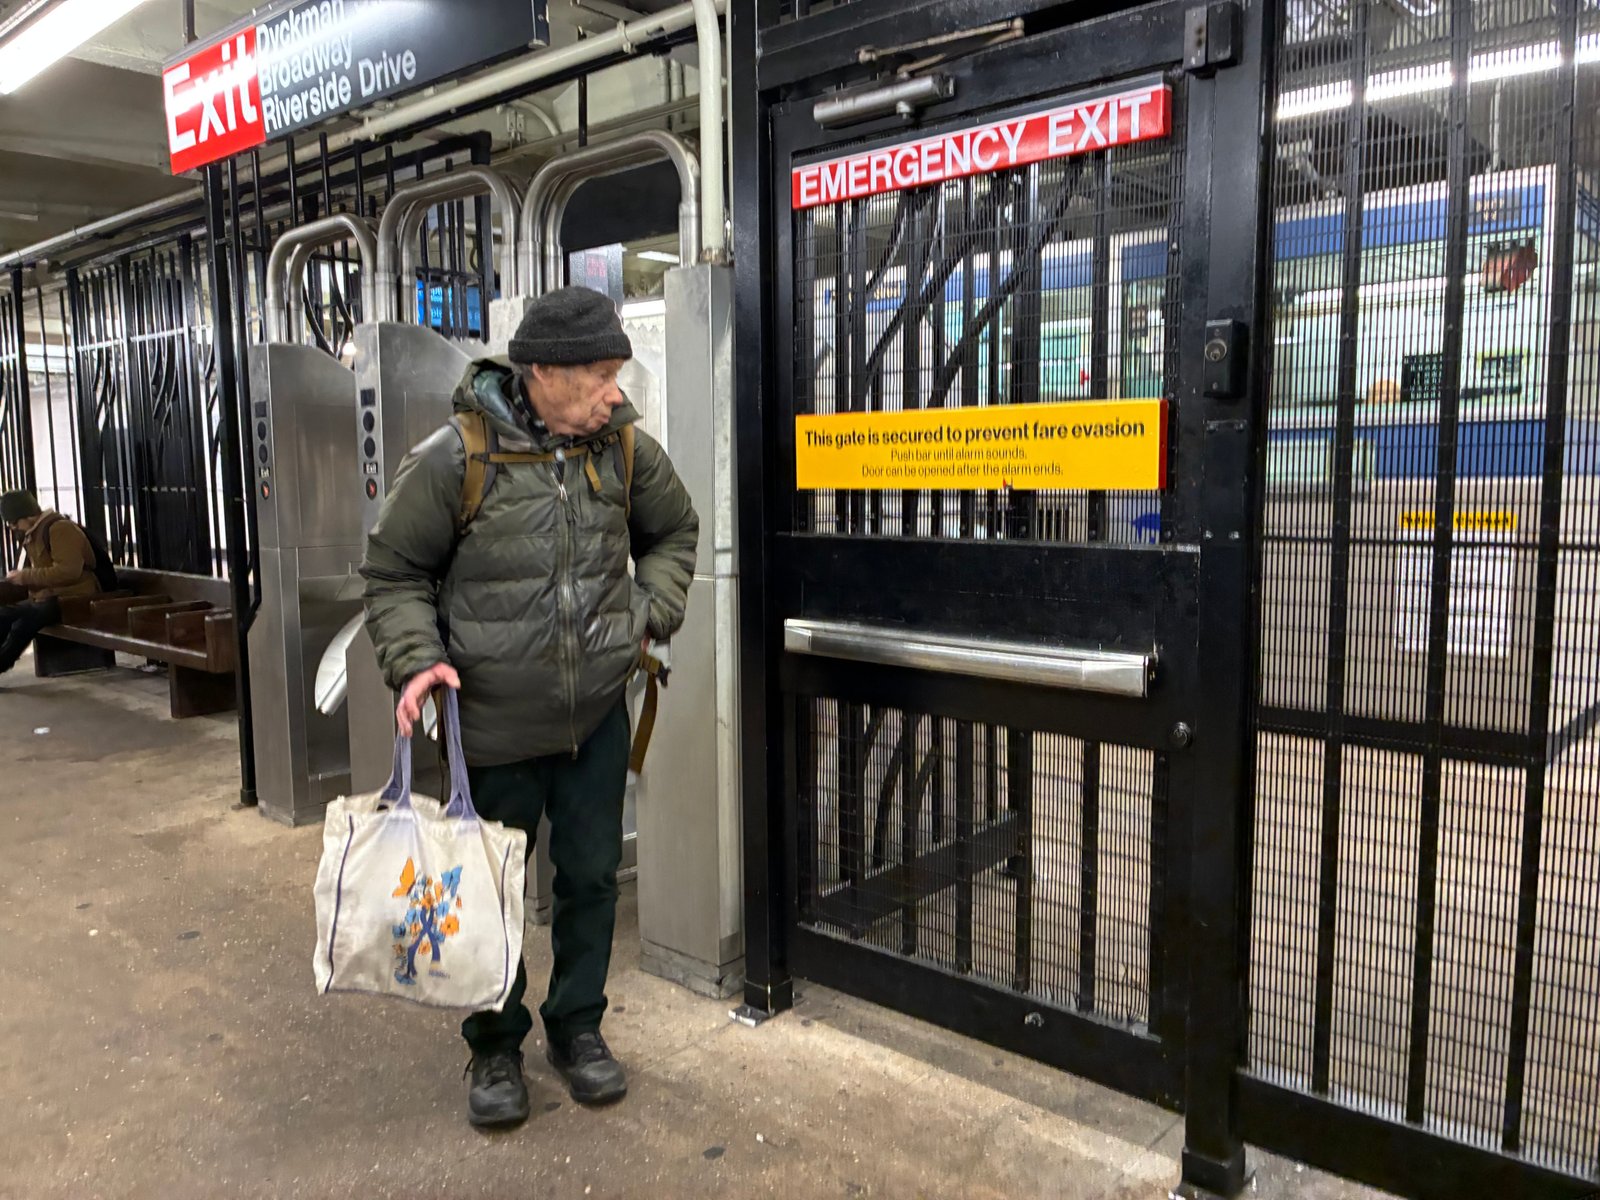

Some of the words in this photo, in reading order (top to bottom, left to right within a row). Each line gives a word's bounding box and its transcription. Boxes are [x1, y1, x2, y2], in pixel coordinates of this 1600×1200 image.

[256, 0, 345, 53] Dyckman
[163, 33, 259, 154] Exit
[258, 33, 353, 96] Broadway
[262, 71, 352, 134] Riverside
[359, 49, 417, 98] Drive
[799, 121, 1027, 205] EMERGENCY
[1048, 92, 1153, 156] EXIT
[805, 429, 833, 447] This
[835, 429, 866, 450] gate
[868, 428, 880, 445] is
[882, 425, 943, 445] secured
[946, 426, 962, 443] to
[965, 422, 1030, 444] prevent
[1033, 420, 1068, 440] fare
[1071, 417, 1145, 439] evasion
[891, 449, 915, 462] Push
[916, 448, 932, 461] bar
[933, 448, 954, 461] until
[955, 447, 984, 461] alarm
[986, 446, 1027, 460] sounds.
[862, 464, 884, 478] Door
[885, 466, 903, 477] can
[904, 463, 917, 477] be
[918, 463, 955, 479] opened
[956, 463, 980, 476] after
[983, 462, 1000, 476] the
[1001, 462, 1032, 476] alarm
[1033, 461, 1064, 475] ends.
